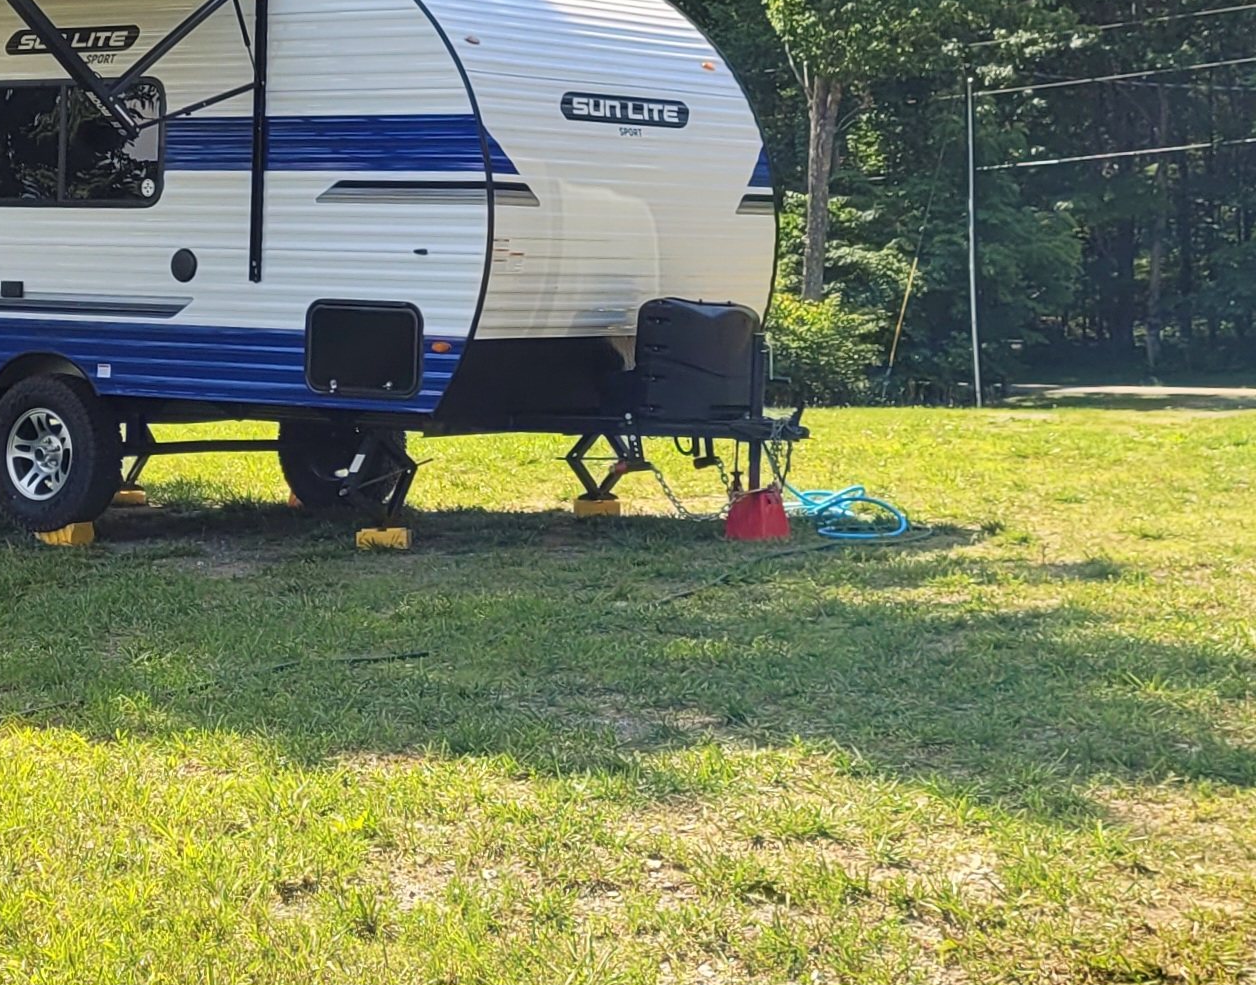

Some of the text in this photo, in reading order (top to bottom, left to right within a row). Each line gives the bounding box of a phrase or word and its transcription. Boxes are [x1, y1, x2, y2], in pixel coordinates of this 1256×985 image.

[71, 30, 129, 48] LITE
[86, 53, 117, 65] SPORT
[572, 97, 680, 123] SUN LITE
[619, 127, 642, 137] SPORT
